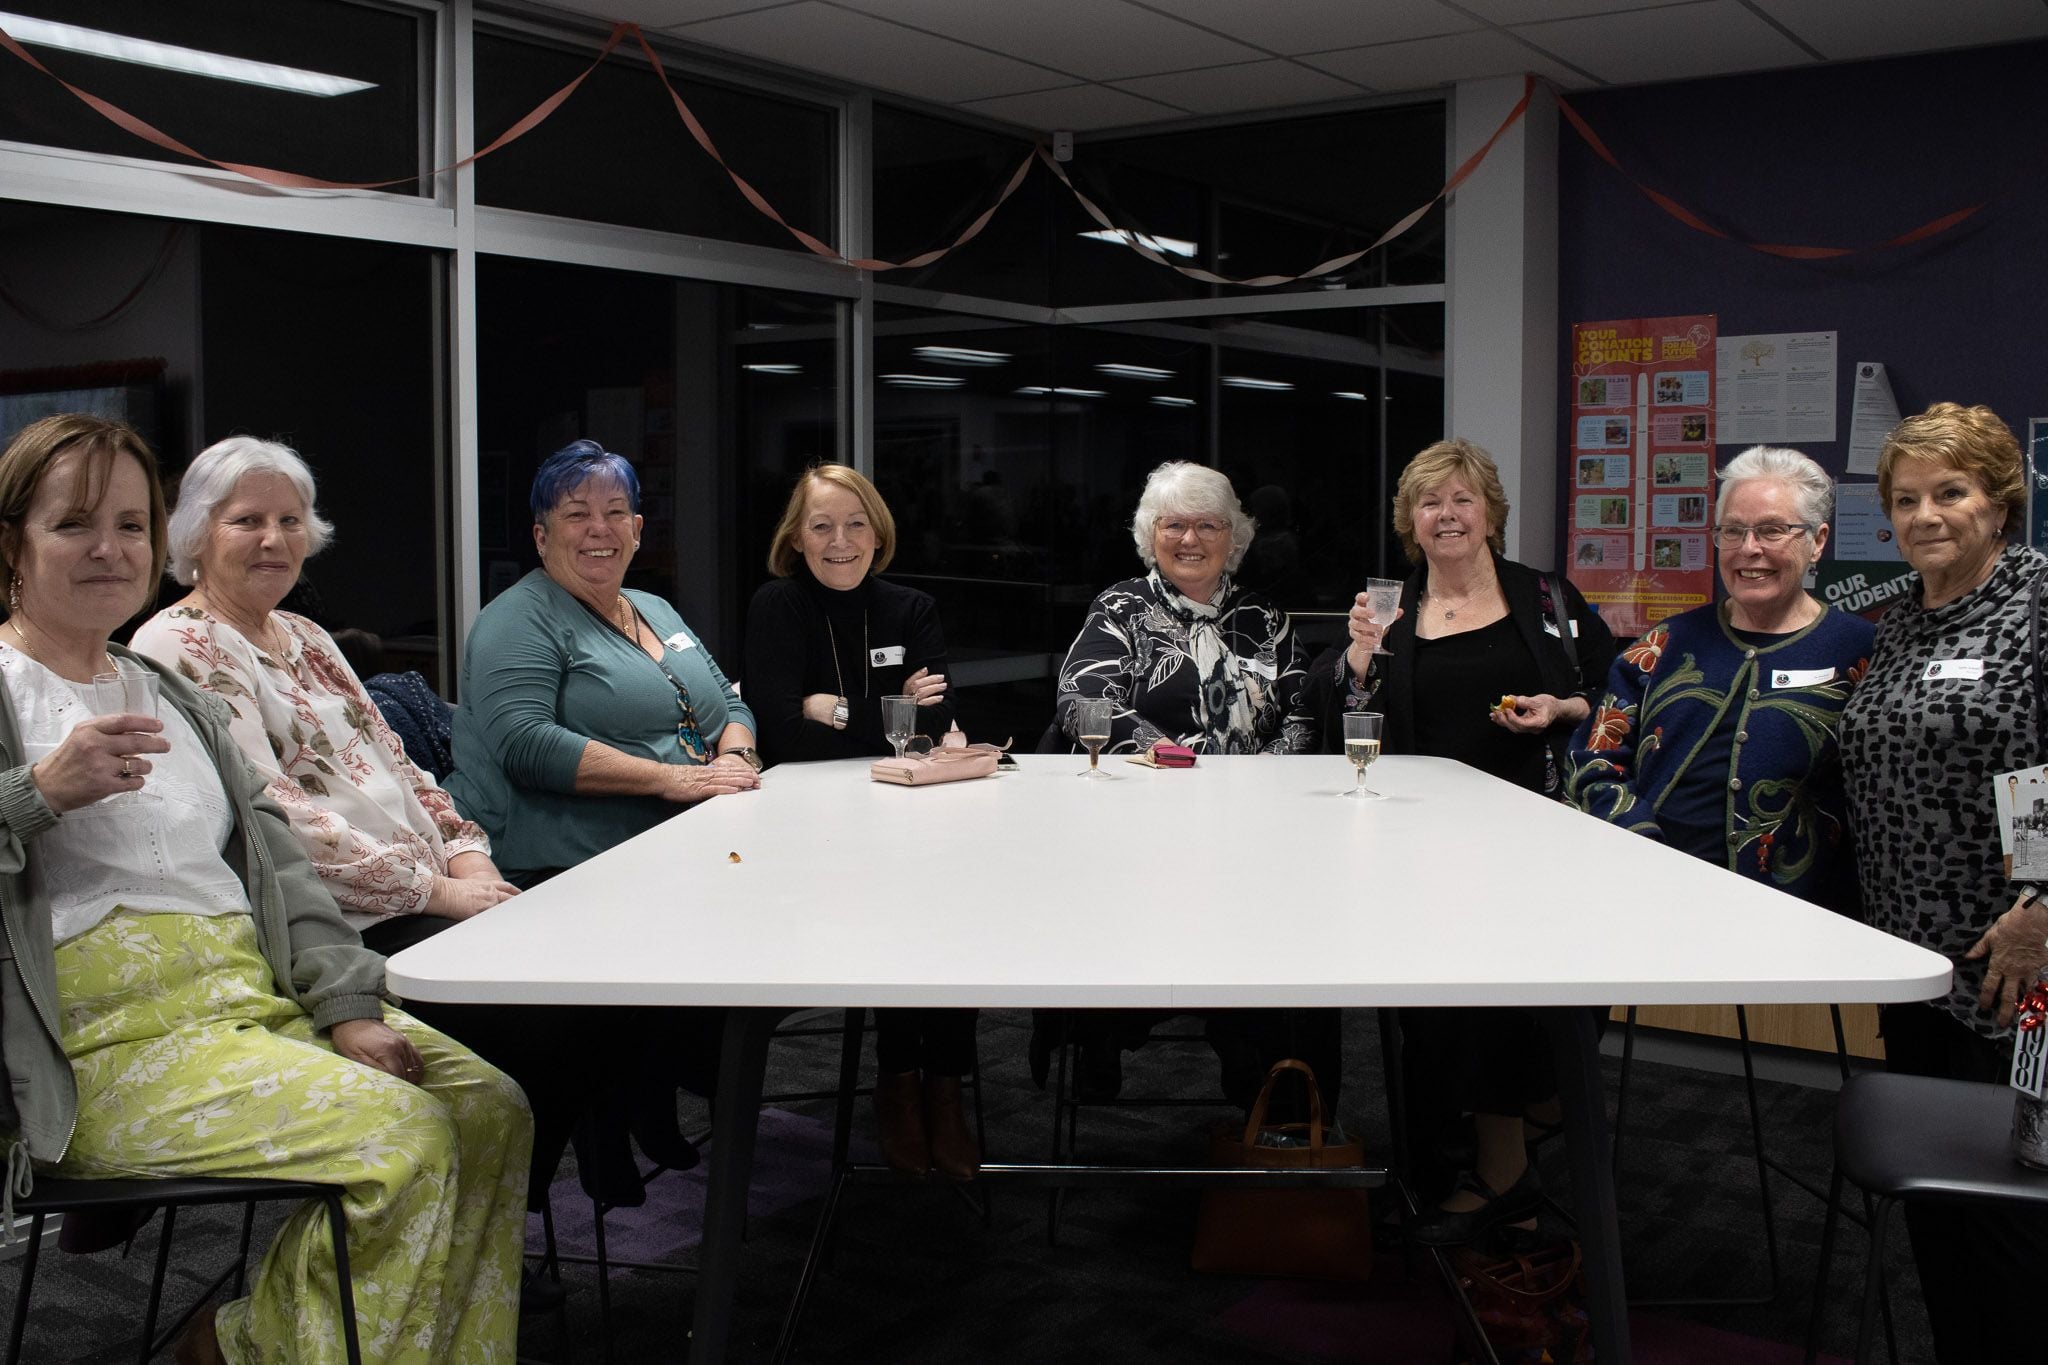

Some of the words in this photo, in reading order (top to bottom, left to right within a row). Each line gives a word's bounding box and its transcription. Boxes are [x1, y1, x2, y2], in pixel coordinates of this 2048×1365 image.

[1579, 329, 1617, 342] YOUR
[1579, 337, 1653, 352] DONATION
[1579, 348, 1653, 366] COUNTS
[1825, 573, 1868, 601] OUR
[1829, 570, 1919, 612] TUDENTS
[2015, 1051, 2040, 1092] 81
